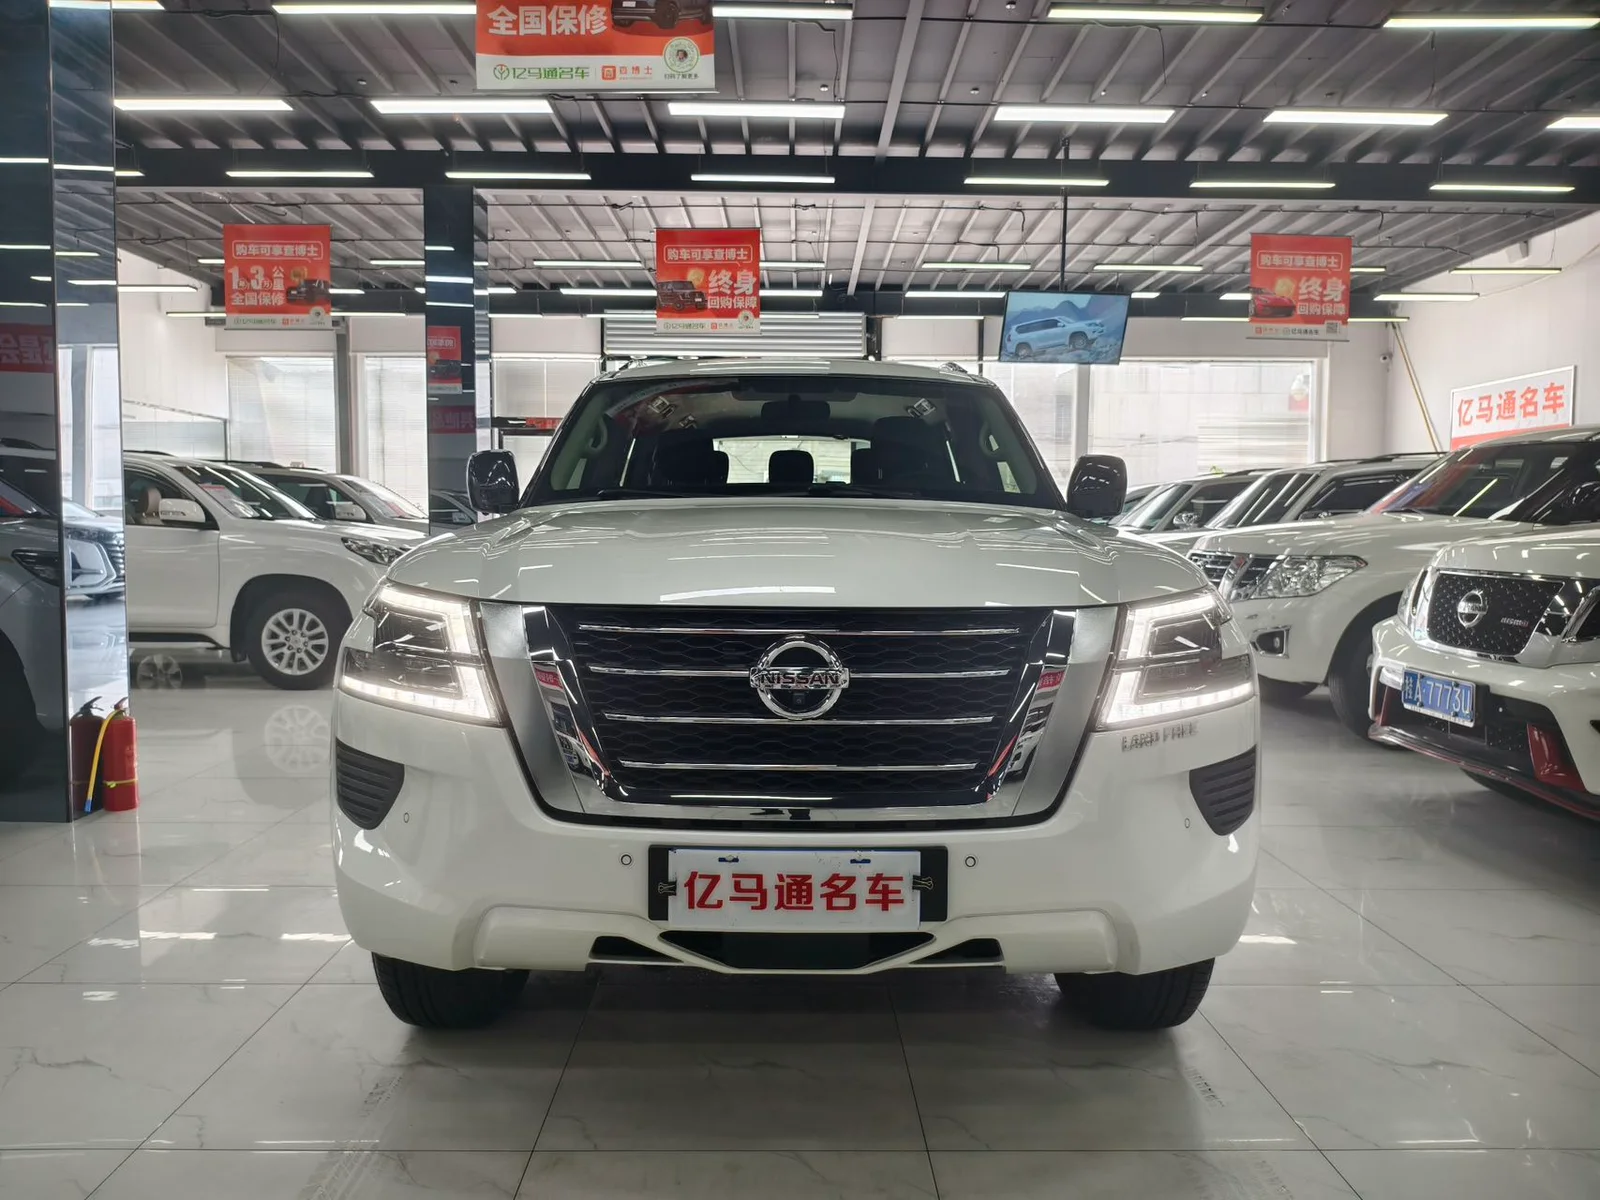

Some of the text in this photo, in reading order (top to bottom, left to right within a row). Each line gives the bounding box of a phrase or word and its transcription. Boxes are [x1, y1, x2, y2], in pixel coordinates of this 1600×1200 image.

[487, 5, 607, 36] 全国保修
[512, 67, 590, 80] 亿马通名车
[236, 243, 319, 257] 购车可享查博士
[667, 248, 748, 260] 购车可享查博士
[1260, 254, 1339, 268] 购车可享查博士
[708, 269, 757, 295] 终身
[1298, 276, 1347, 302] 终身
[231, 291, 285, 306] 全国保修
[707, 296, 757, 309] 回购保障
[1297, 302, 1347, 316] 回购保障
[1457, 382, 1565, 427] 亿马通名车
[760, 671, 840, 685] NISSAN
[684, 871, 904, 912] 亿马通名车
